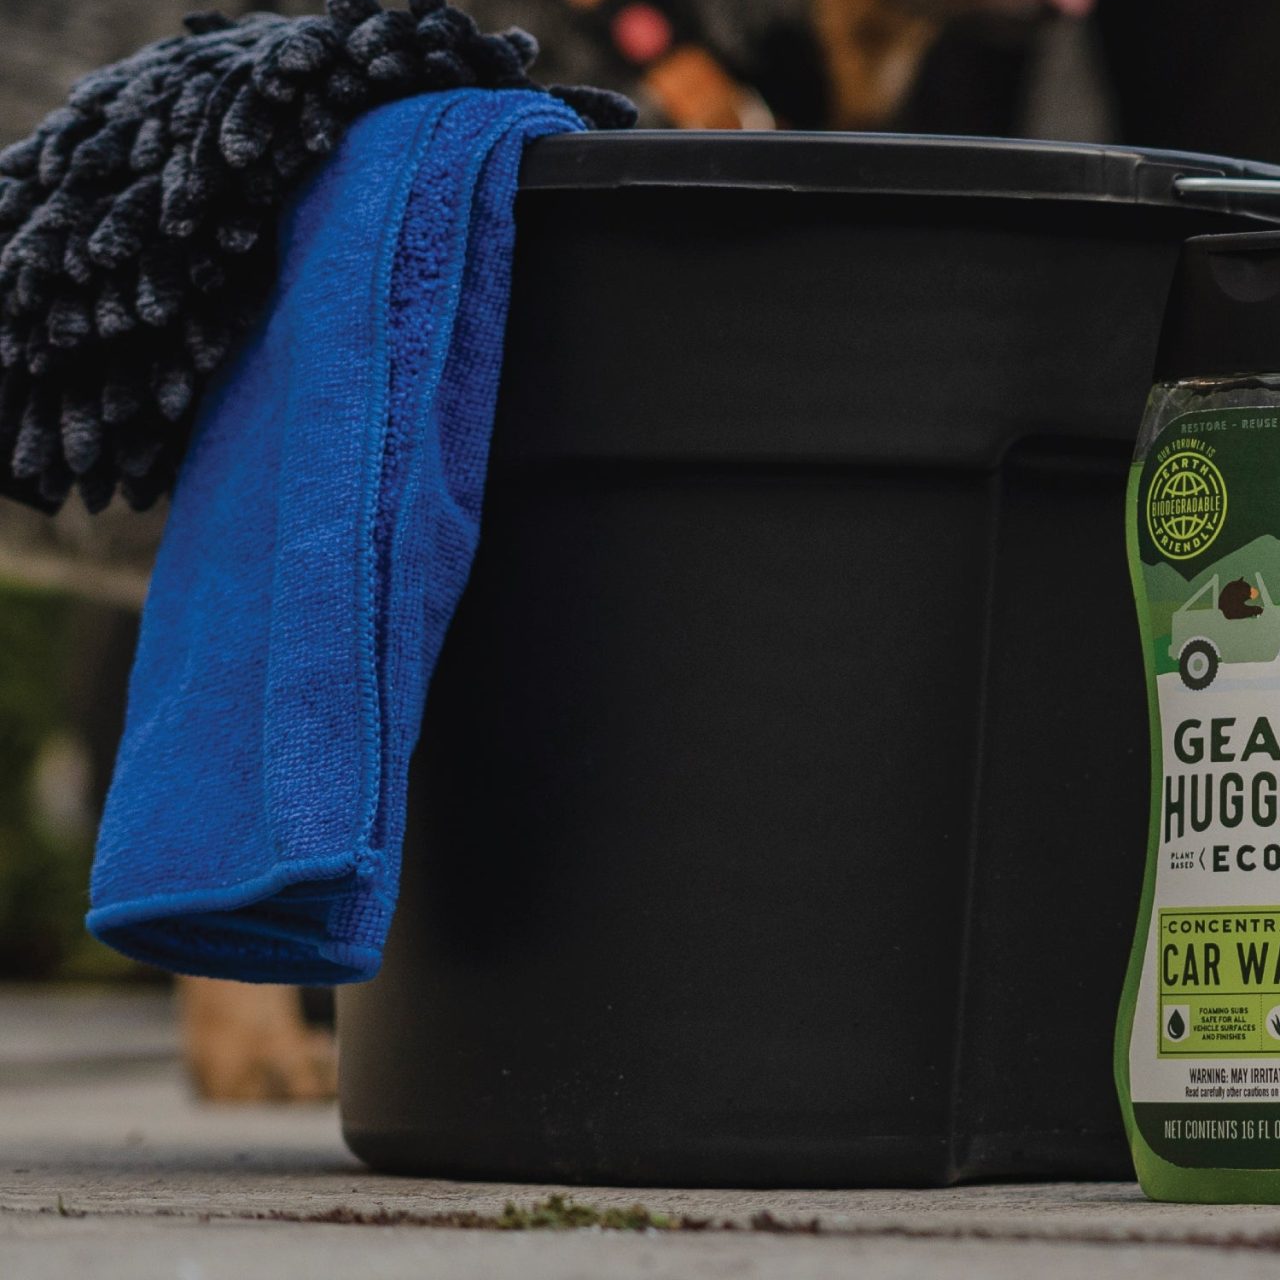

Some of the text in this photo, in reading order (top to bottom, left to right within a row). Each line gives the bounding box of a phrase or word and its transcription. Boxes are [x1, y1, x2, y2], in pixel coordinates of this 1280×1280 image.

[1181, 421, 1227, 433] RESTORE
[1242, 418, 1278, 429] REUSE
[1162, 458, 1209, 479] EARTH
[1152, 496, 1220, 517] BIODEGRADABLE
[1156, 521, 1214, 552] FRIENDLY
[1171, 851, 1194, 859] PLANT
[1171, 861, 1194, 869] BASED
[1163, 943, 1221, 986] CAR
[1199, 1007, 1229, 1015] FOAMING
[1233, 1015, 1246, 1023] ALL
[1193, 1024, 1219, 1032] VEHICLE
[1189, 1068, 1229, 1083] WARNING:
[1231, 1068, 1248, 1083] MAY
[1185, 1086, 1199, 1097] Read
[1200, 1086, 1225, 1100] carefully
[1226, 1086, 1242, 1097] other
[1243, 1086, 1270, 1097] cautions
[1270, 1088, 1279, 1097] on
[1164, 1120, 1181, 1139] NET
[1185, 1120, 1238, 1139] CONTENTS
[1242, 1120, 1254, 1139] 16
[1258, 1120, 1270, 1139] FL
